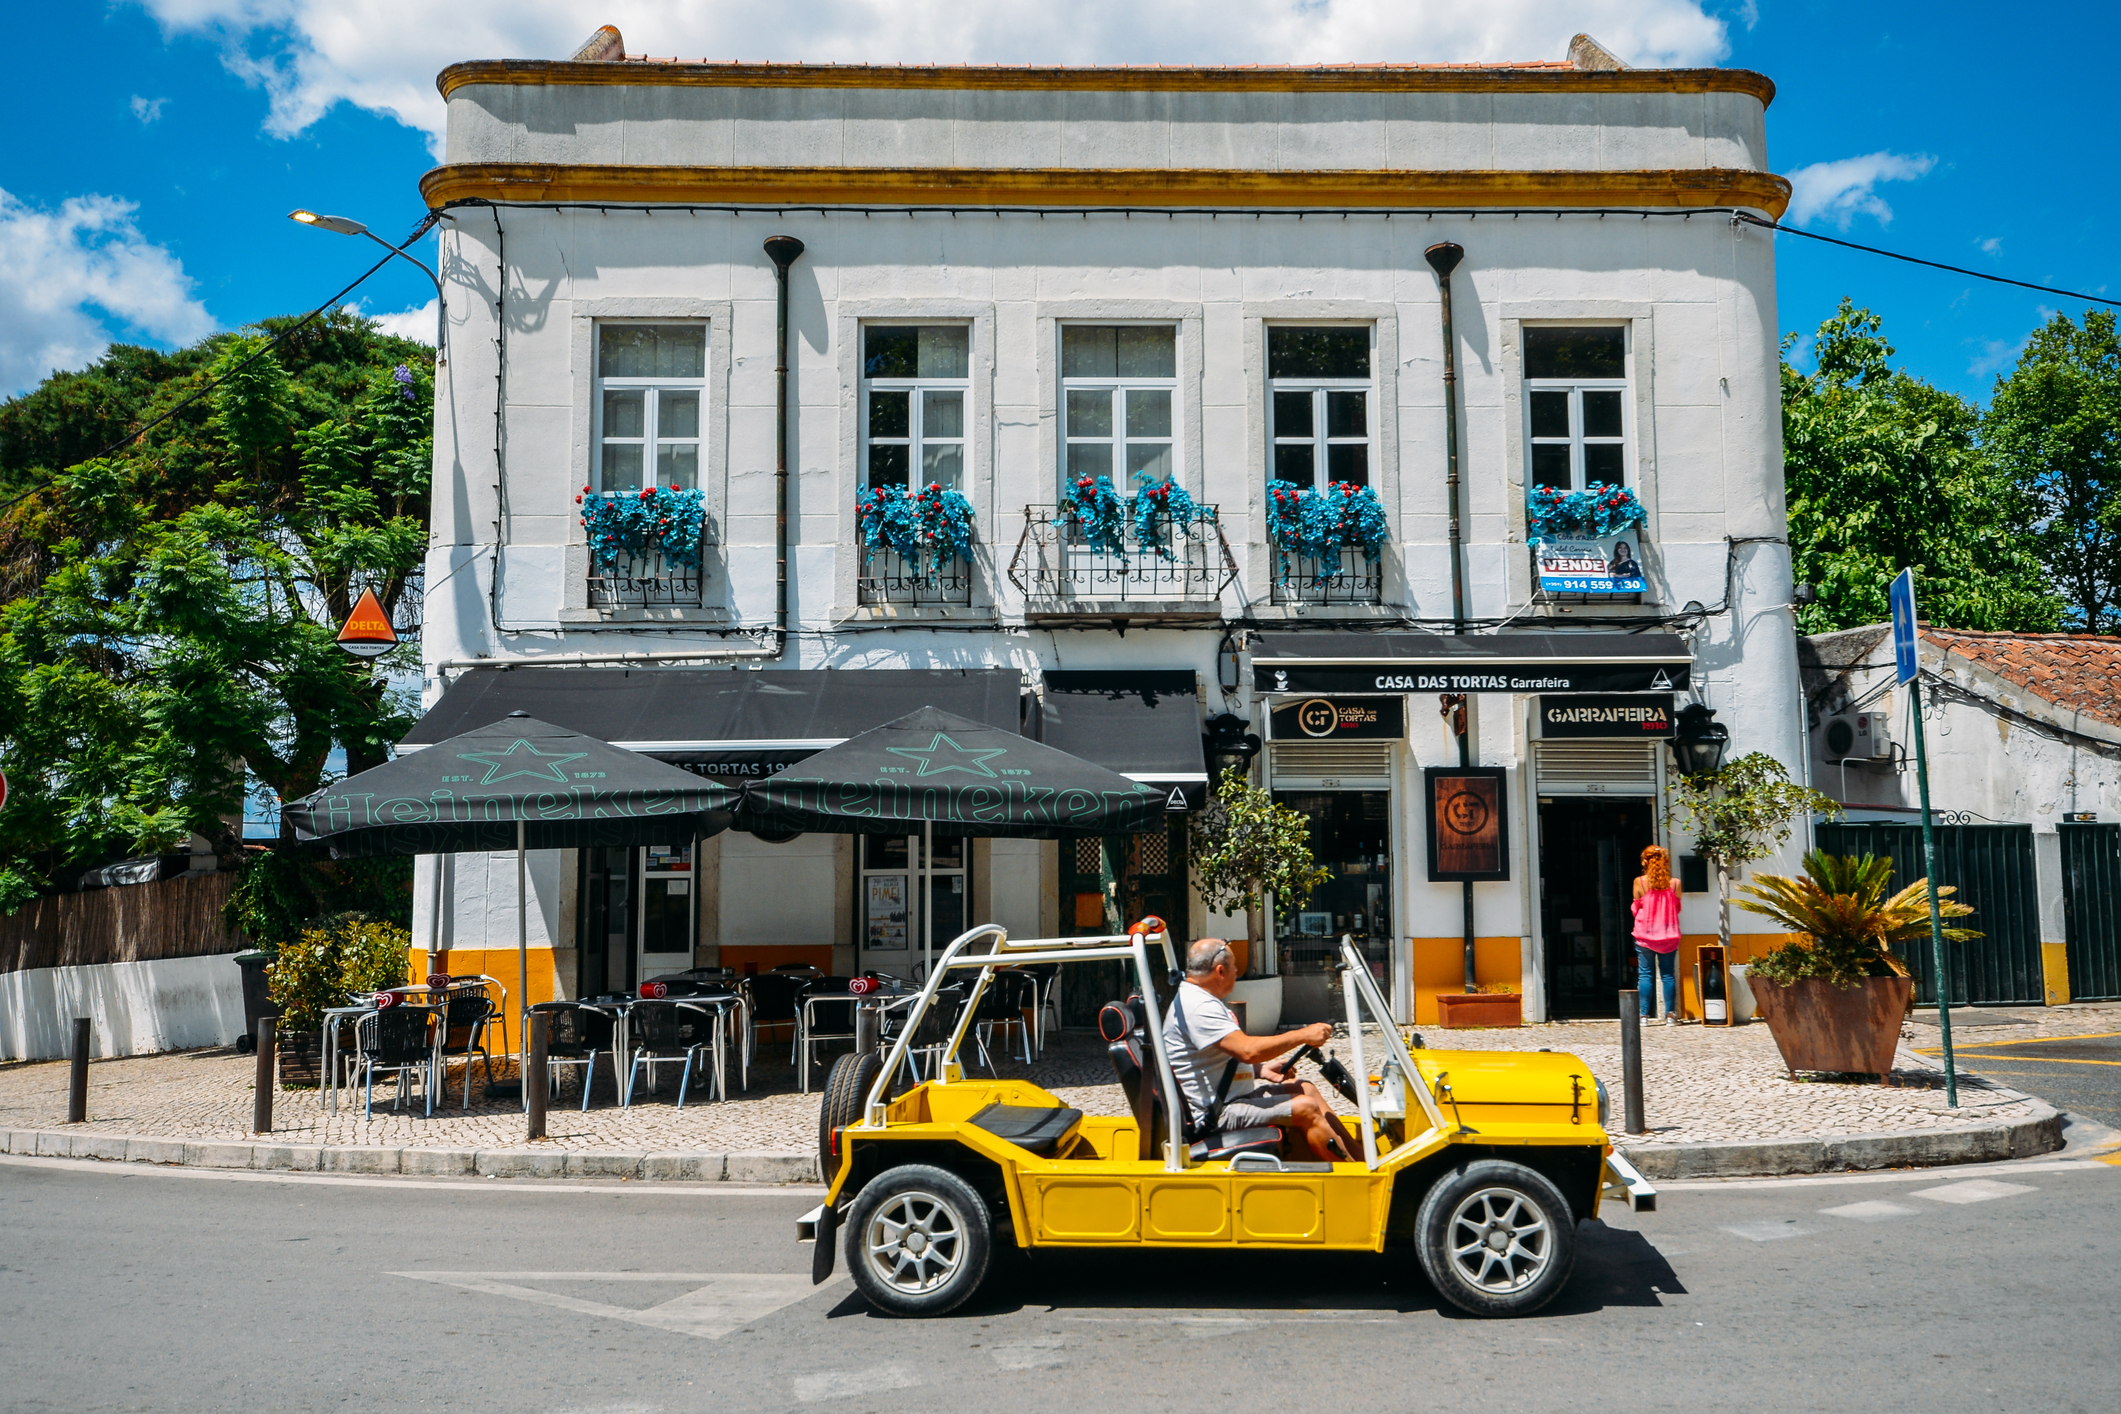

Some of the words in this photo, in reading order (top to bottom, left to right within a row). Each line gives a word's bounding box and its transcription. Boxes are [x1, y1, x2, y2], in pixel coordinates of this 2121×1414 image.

[1545, 559, 1605, 571] VENDE
[1564, 580, 1588, 589] 914
[1590, 581, 1614, 590] 559
[1617, 580, 1640, 589] 130
[350, 621, 386, 630] DELTA
[1375, 676, 1414, 689] CASA
[1418, 676, 1448, 689] DAS
[1451, 675, 1508, 689] TORTAS
[1510, 677, 1570, 688] Garrafeira
[1338, 707, 1365, 715] CASA
[1547, 707, 1668, 723] GARRAFEIRA
[1338, 714, 1377, 722] TORTAS
[1641, 721, 1668, 730] 1910
[698, 763, 760, 775] TORTAS
[766, 762, 794, 775] 19
[1000, 768, 1032, 776] 1873
[574, 771, 606, 779] 1873
[763, 778, 1147, 832] Heineken
[303, 785, 730, 838] Heineken
